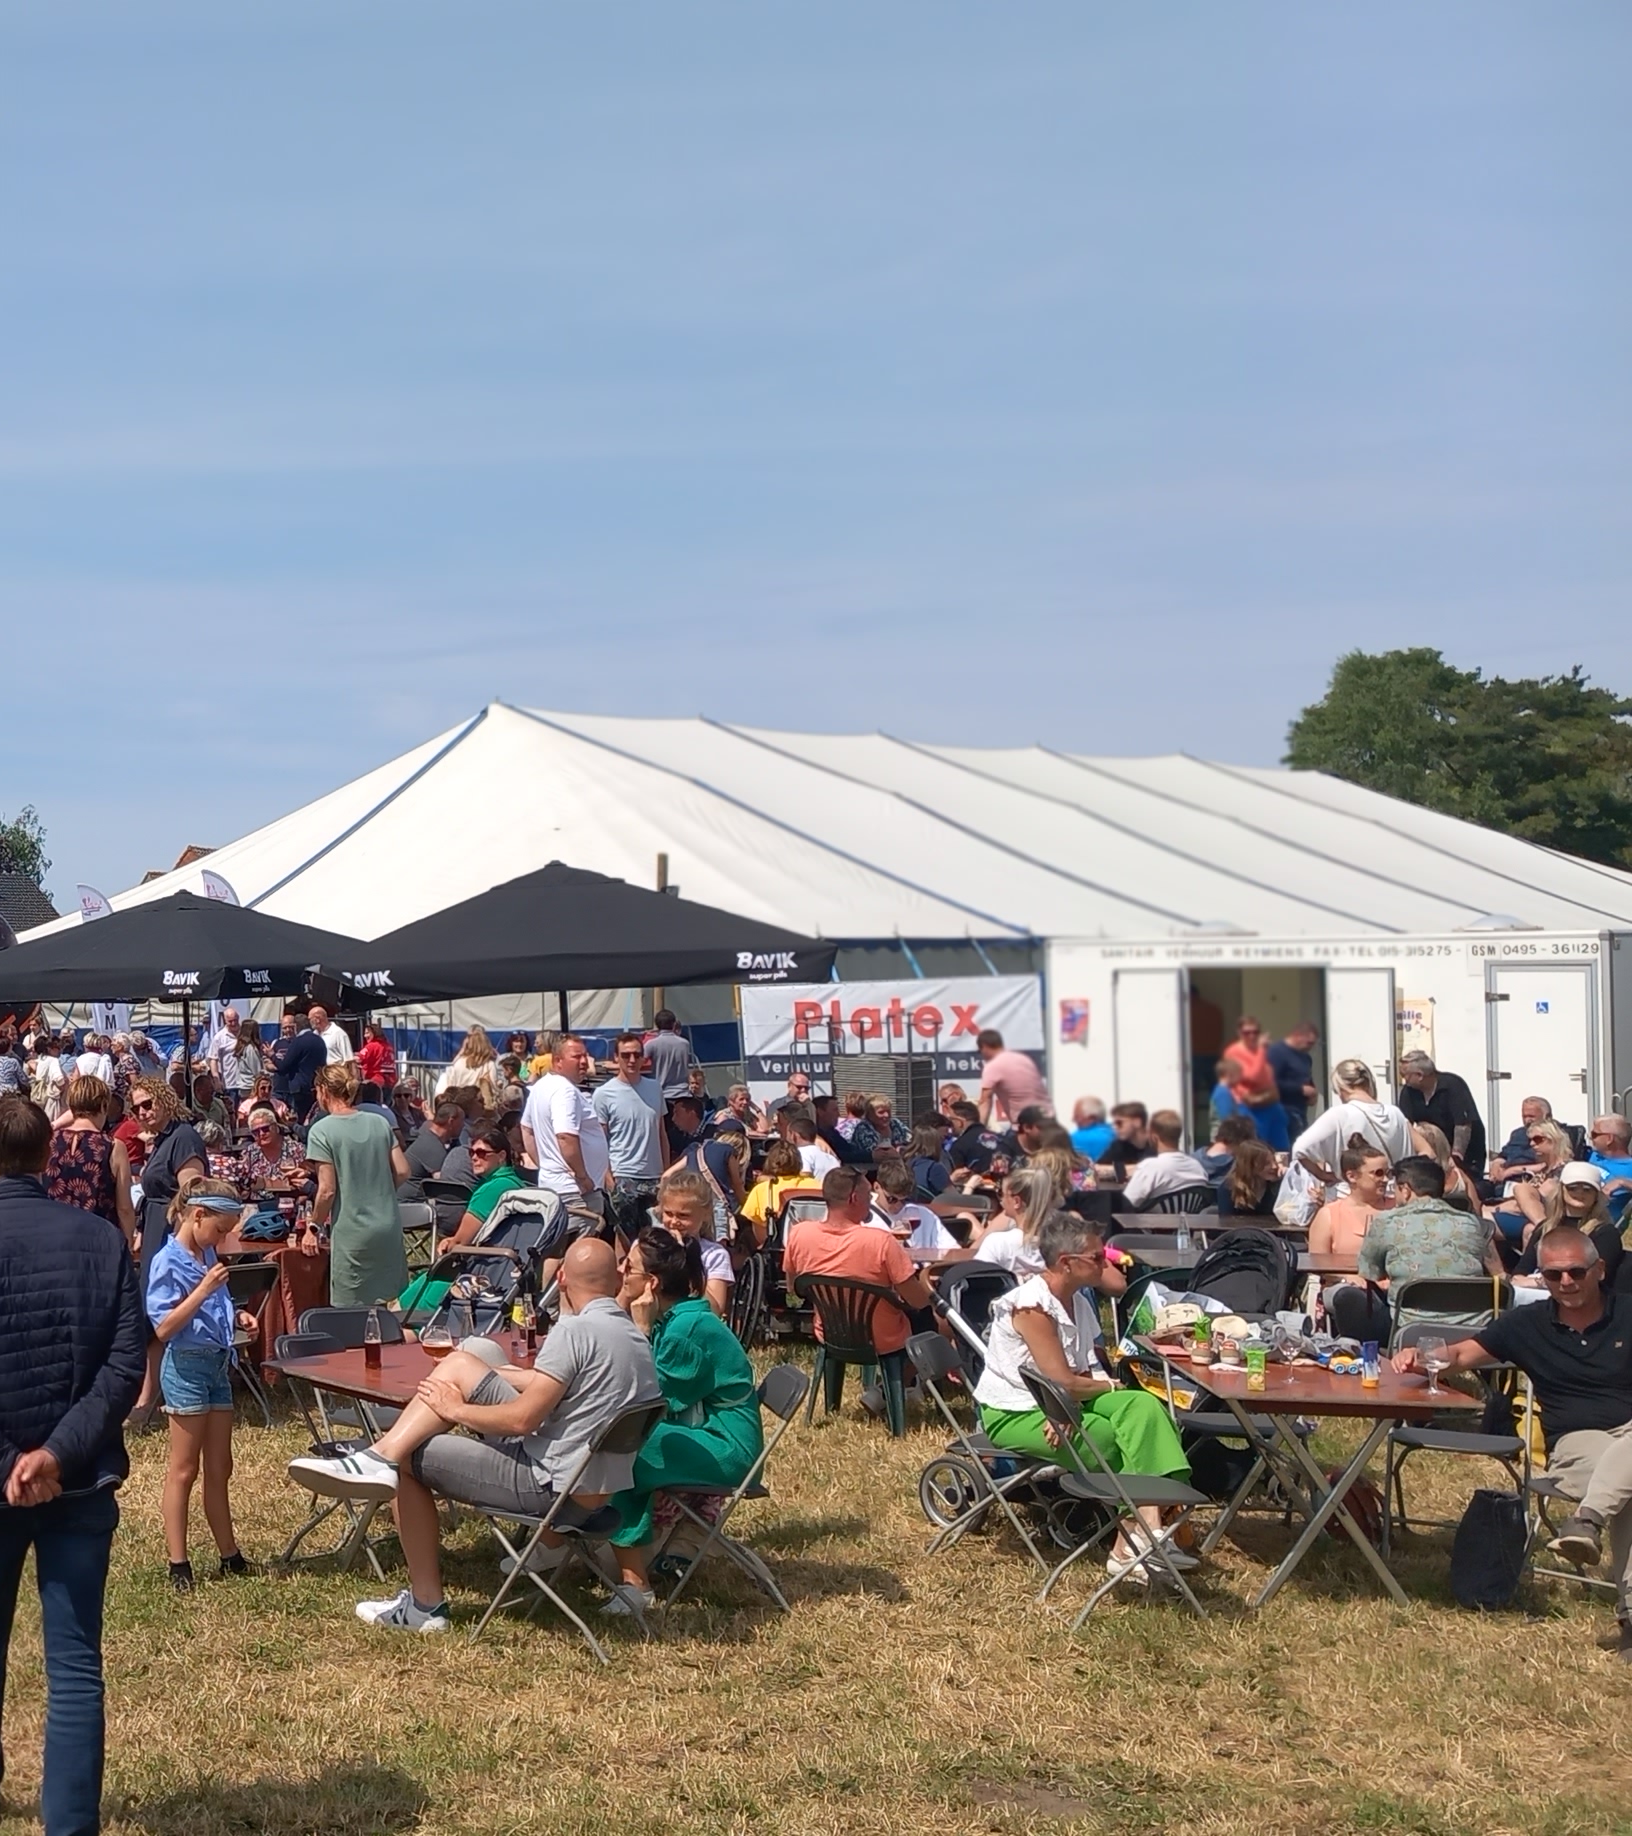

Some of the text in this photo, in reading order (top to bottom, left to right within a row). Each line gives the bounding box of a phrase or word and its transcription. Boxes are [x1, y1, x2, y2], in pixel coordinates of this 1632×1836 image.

[1471, 945, 1497, 957] GSM
[736, 951, 799, 969] BAVIK
[163, 970, 200, 985] BAVIK
[243, 969, 272, 984] BAVIK
[793, 997, 983, 1042] Platex
